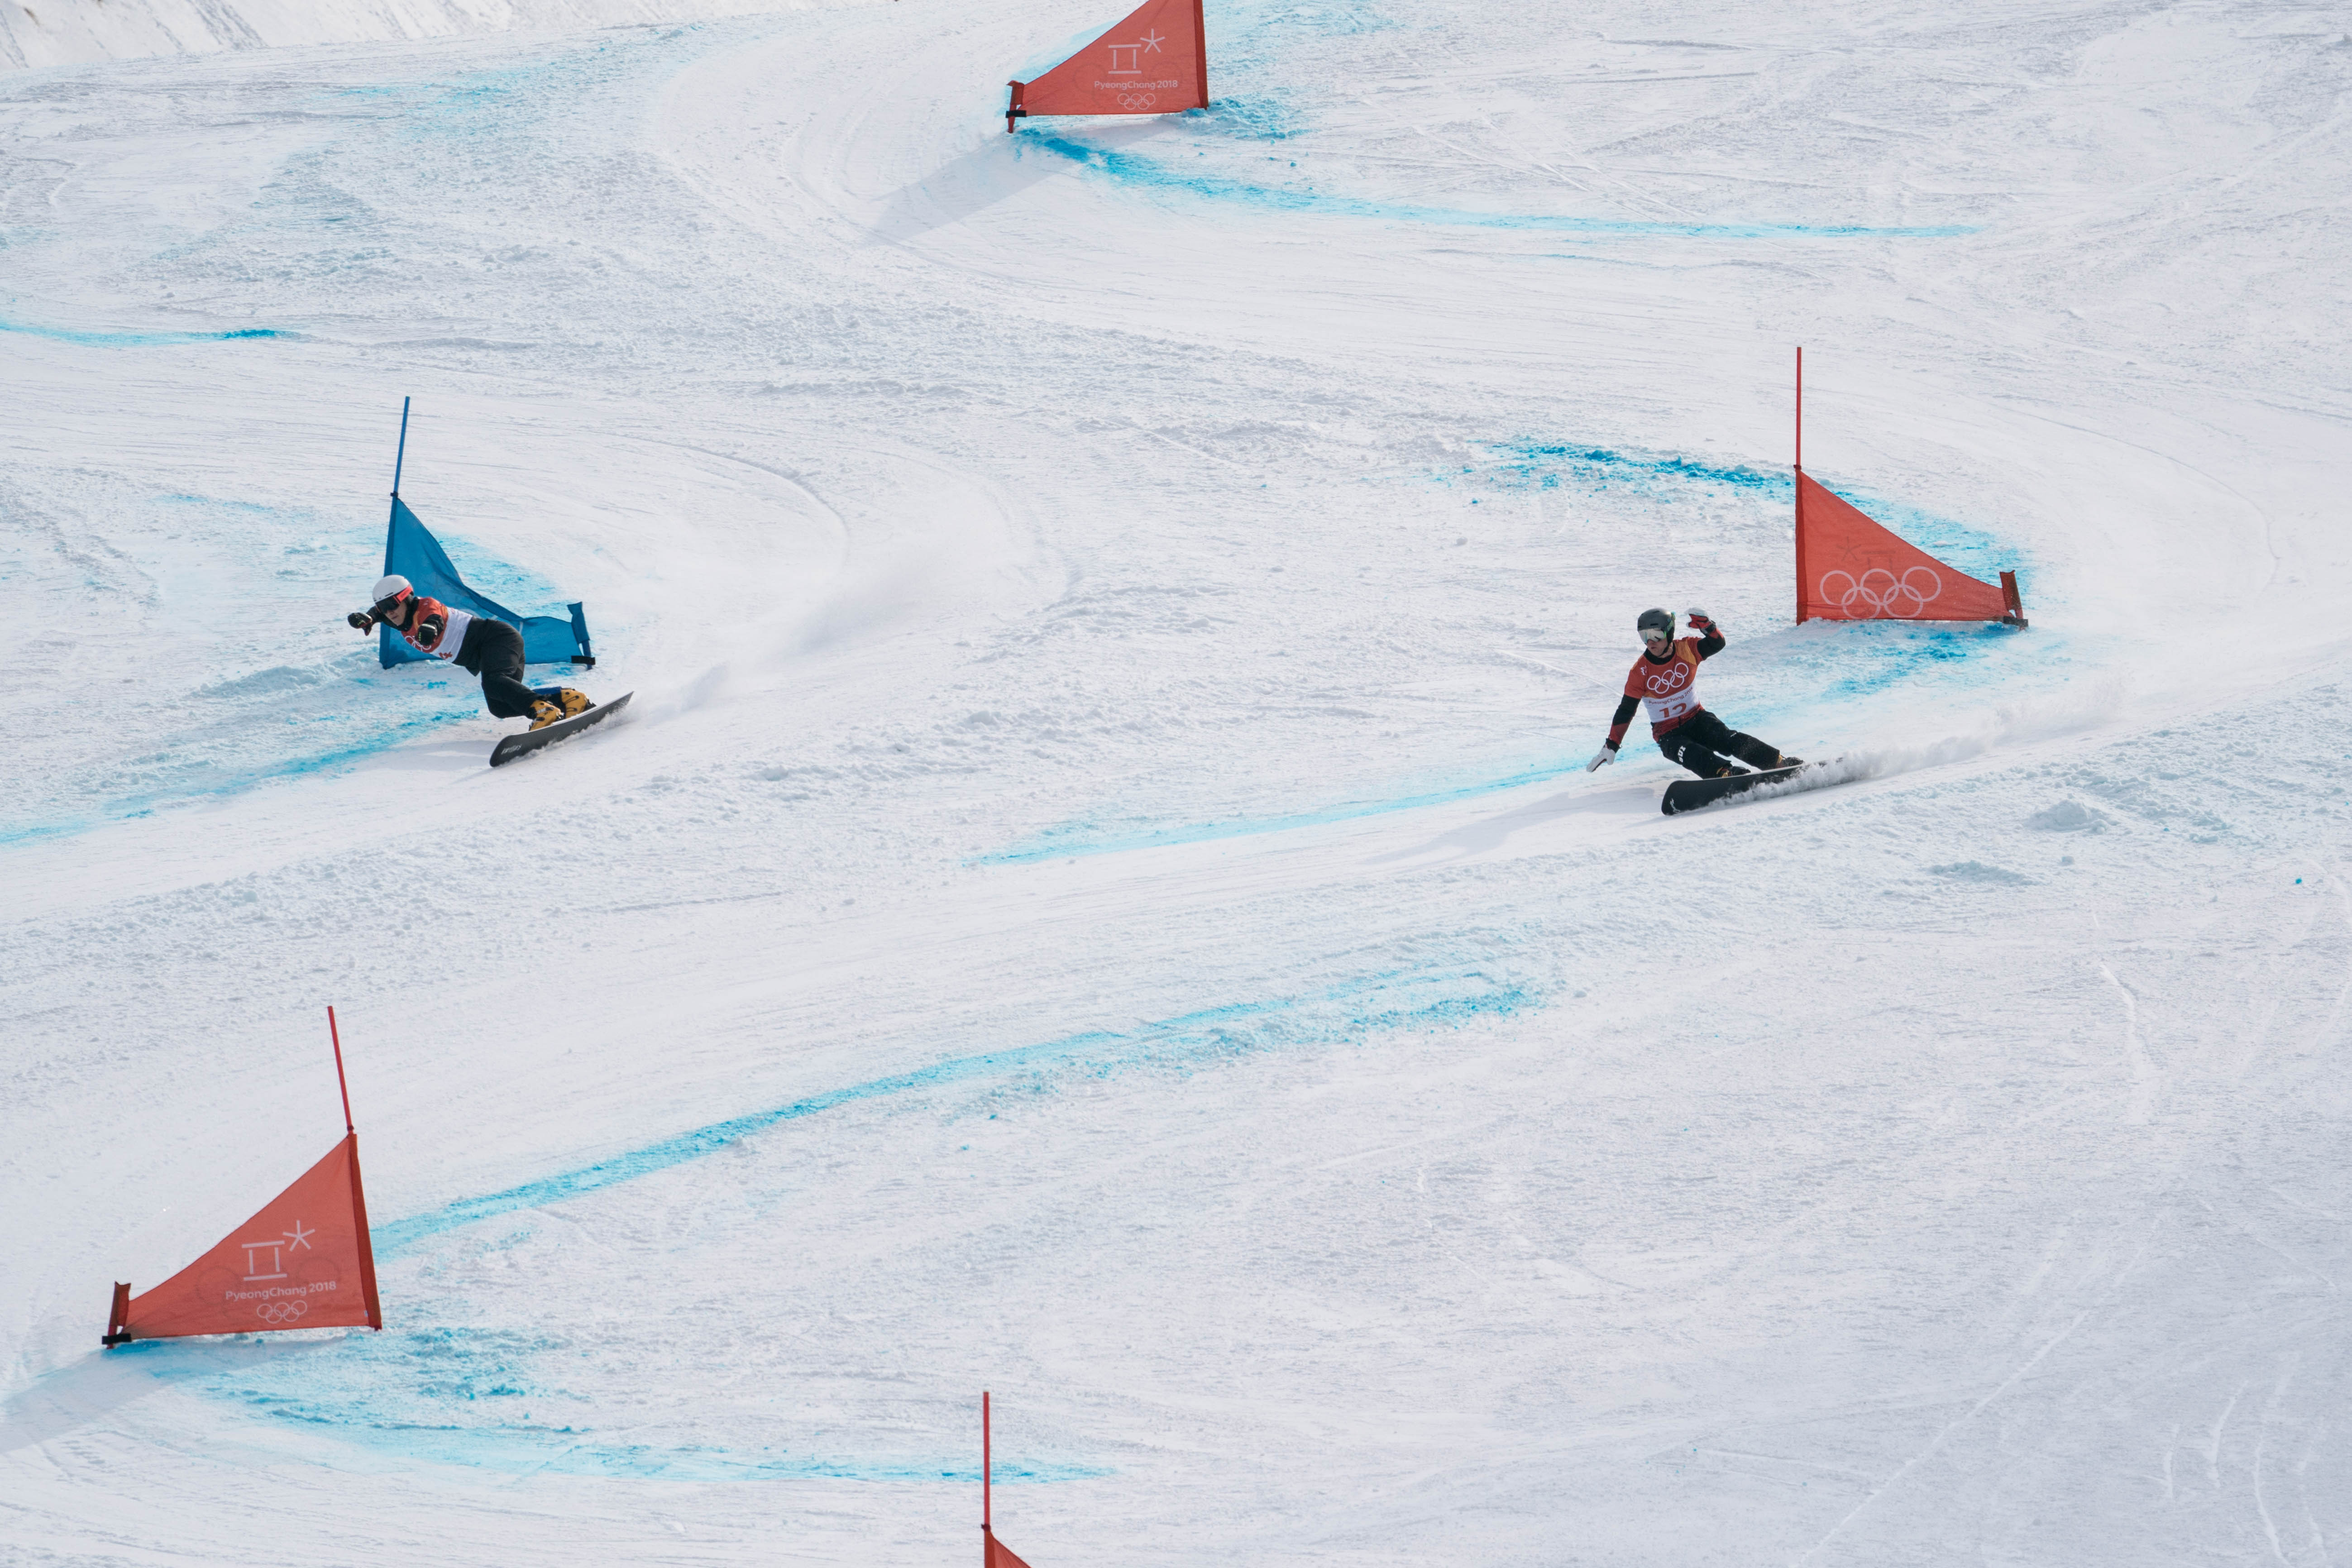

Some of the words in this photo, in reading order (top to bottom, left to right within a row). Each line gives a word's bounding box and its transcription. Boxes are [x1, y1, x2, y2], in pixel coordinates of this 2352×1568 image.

[1094, 81, 1156, 90] PyeongChang
[226, 1286, 306, 1301] PyeongChang
[309, 1281, 336, 1293] 2018
